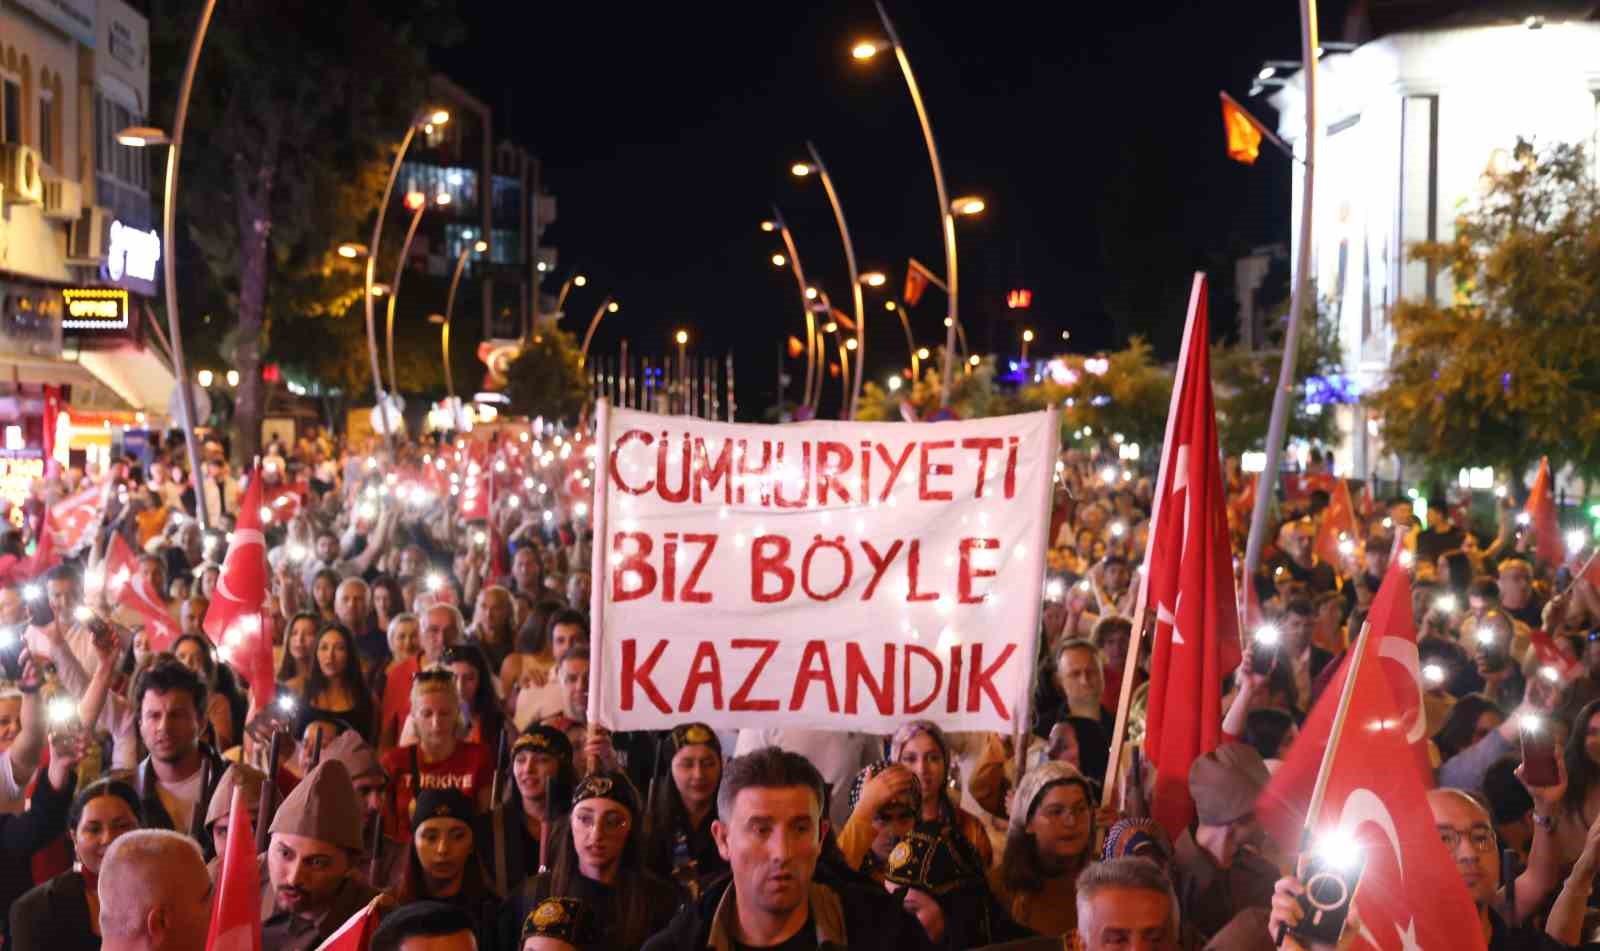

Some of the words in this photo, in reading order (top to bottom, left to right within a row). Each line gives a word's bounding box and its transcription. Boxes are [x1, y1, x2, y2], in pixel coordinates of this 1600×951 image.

[609, 429, 1020, 508] CÜMHURİYETİ
[612, 531, 719, 604] BİZ
[751, 534, 1001, 604] BÖYLE
[620, 638, 1017, 721] KAZANDIK
